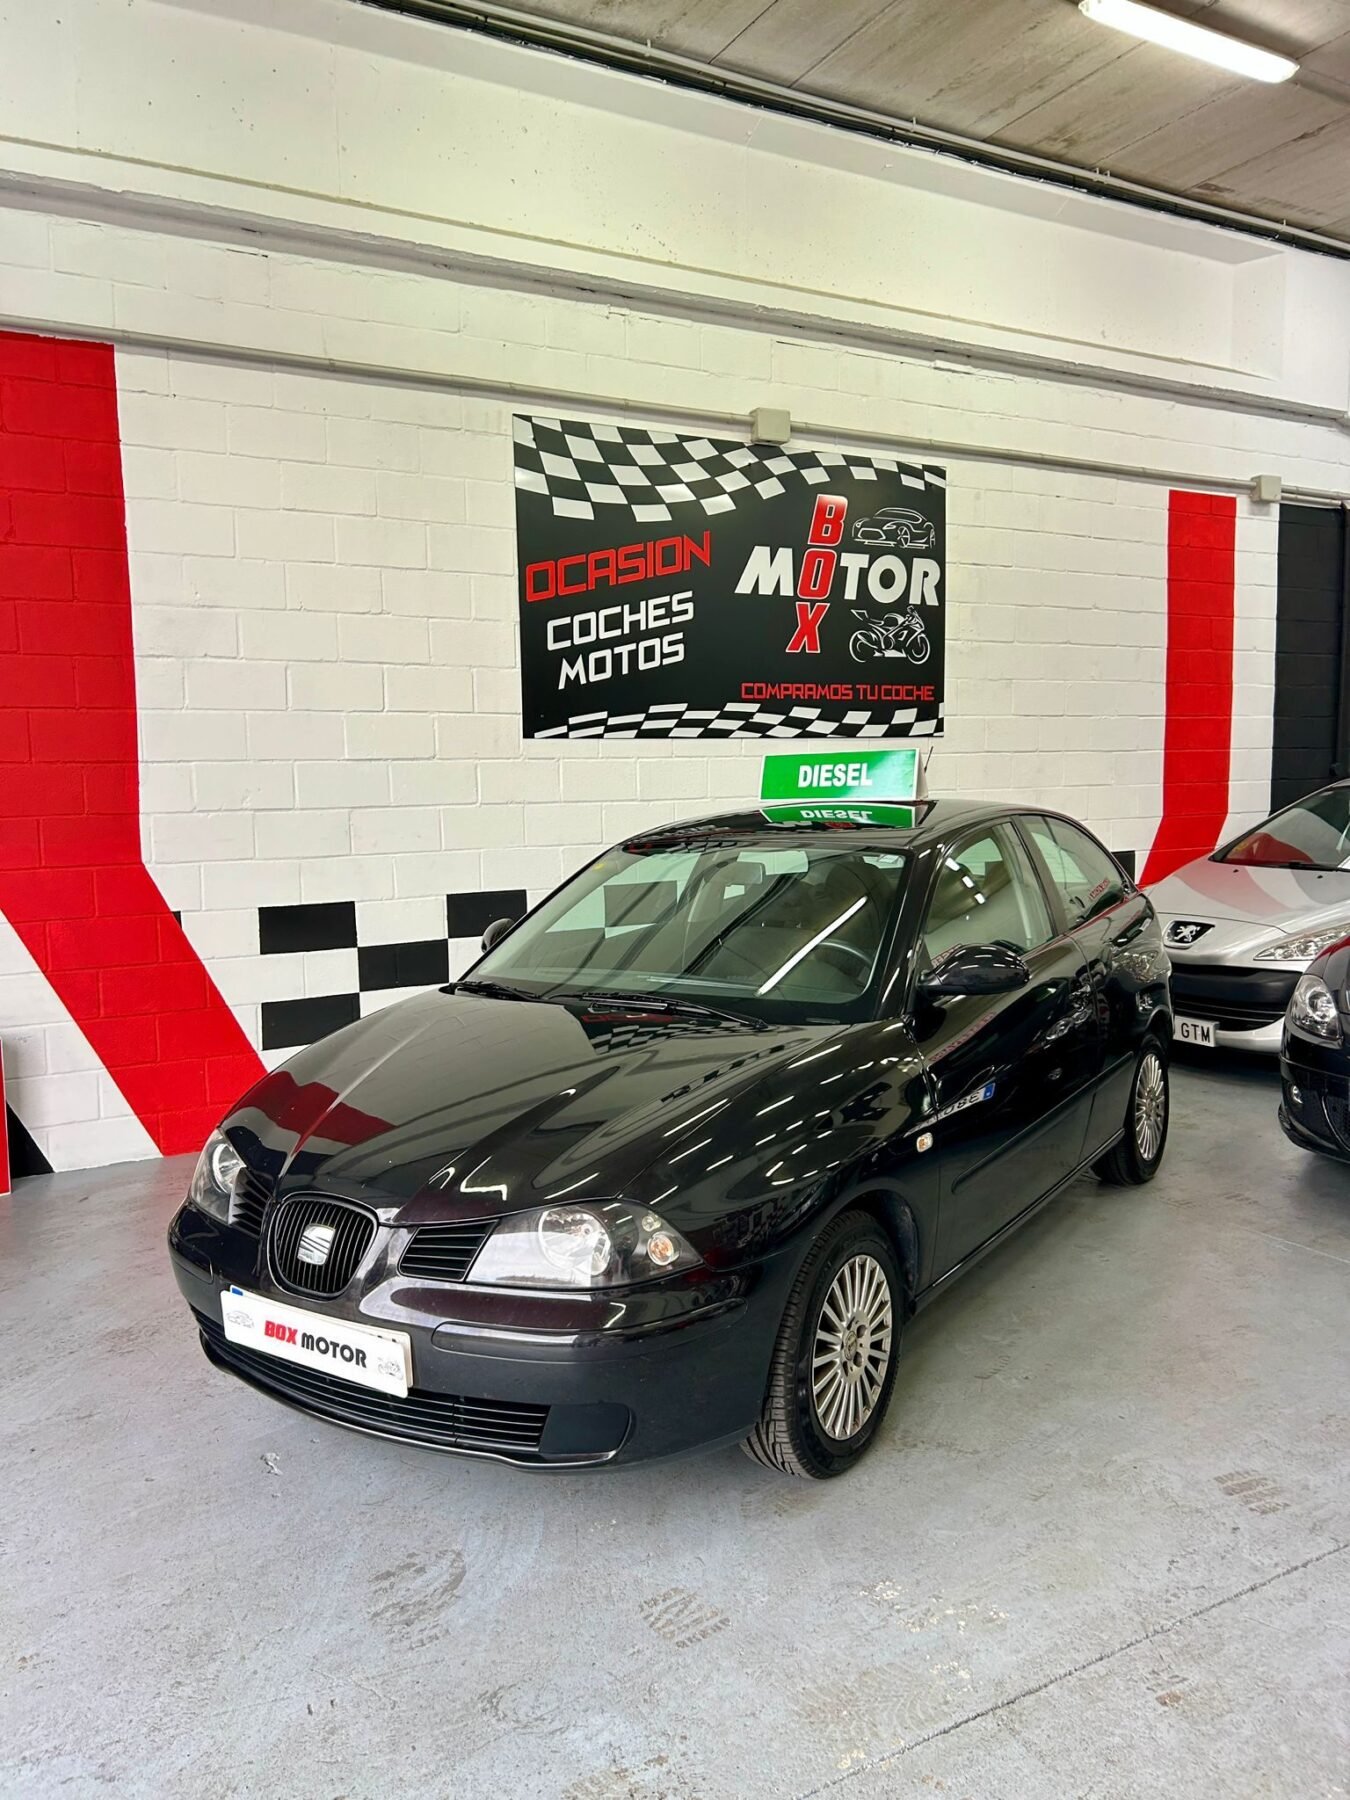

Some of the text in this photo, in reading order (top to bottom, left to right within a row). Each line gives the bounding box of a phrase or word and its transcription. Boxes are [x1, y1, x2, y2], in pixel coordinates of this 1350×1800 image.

[525, 529, 711, 602] OCASION
[734, 545, 940, 606] MOTOR
[547, 590, 694, 651] COCHES
[558, 631, 685, 690] MOTOS
[741, 682, 935, 701] COMPRAMOS TU COCHE
[797, 763, 873, 788] DIESEL
[1181, 1022, 1210, 1043] GTM
[264, 1320, 367, 1368] BOX MOTOR
